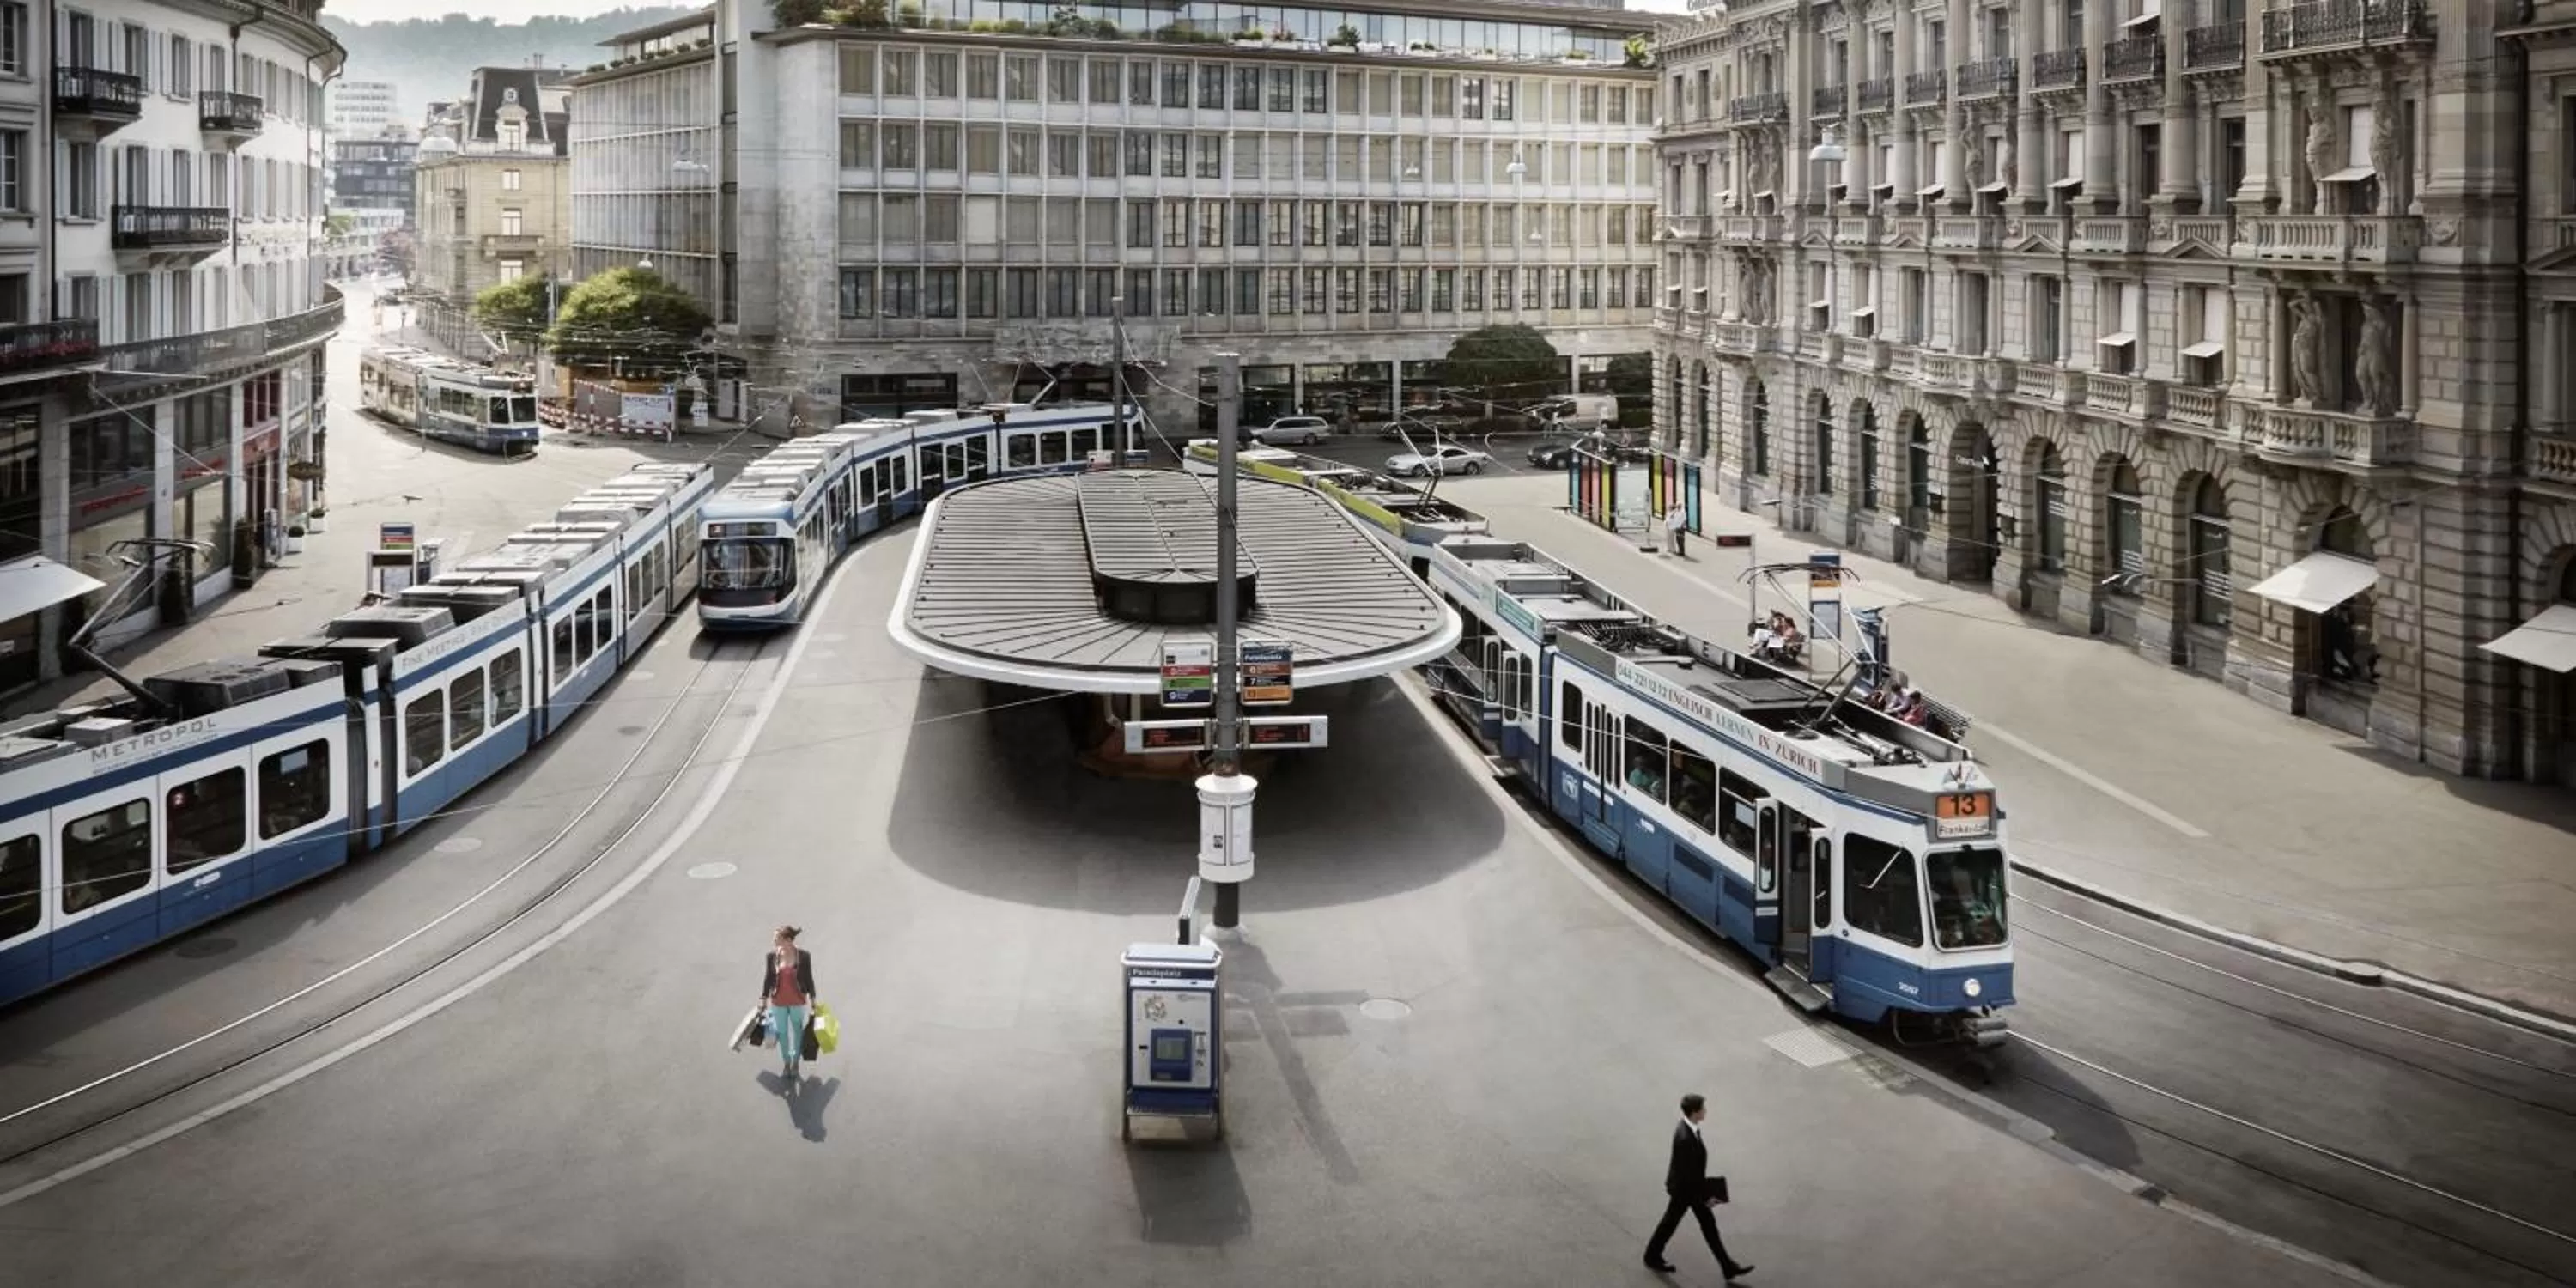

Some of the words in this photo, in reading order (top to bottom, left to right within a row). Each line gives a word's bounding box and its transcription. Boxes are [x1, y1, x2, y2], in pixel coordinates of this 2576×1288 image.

[91, 719, 216, 762] METROPOL
[1950, 793, 1977, 816] 13
[1133, 968, 1182, 979] Paradeplatz
